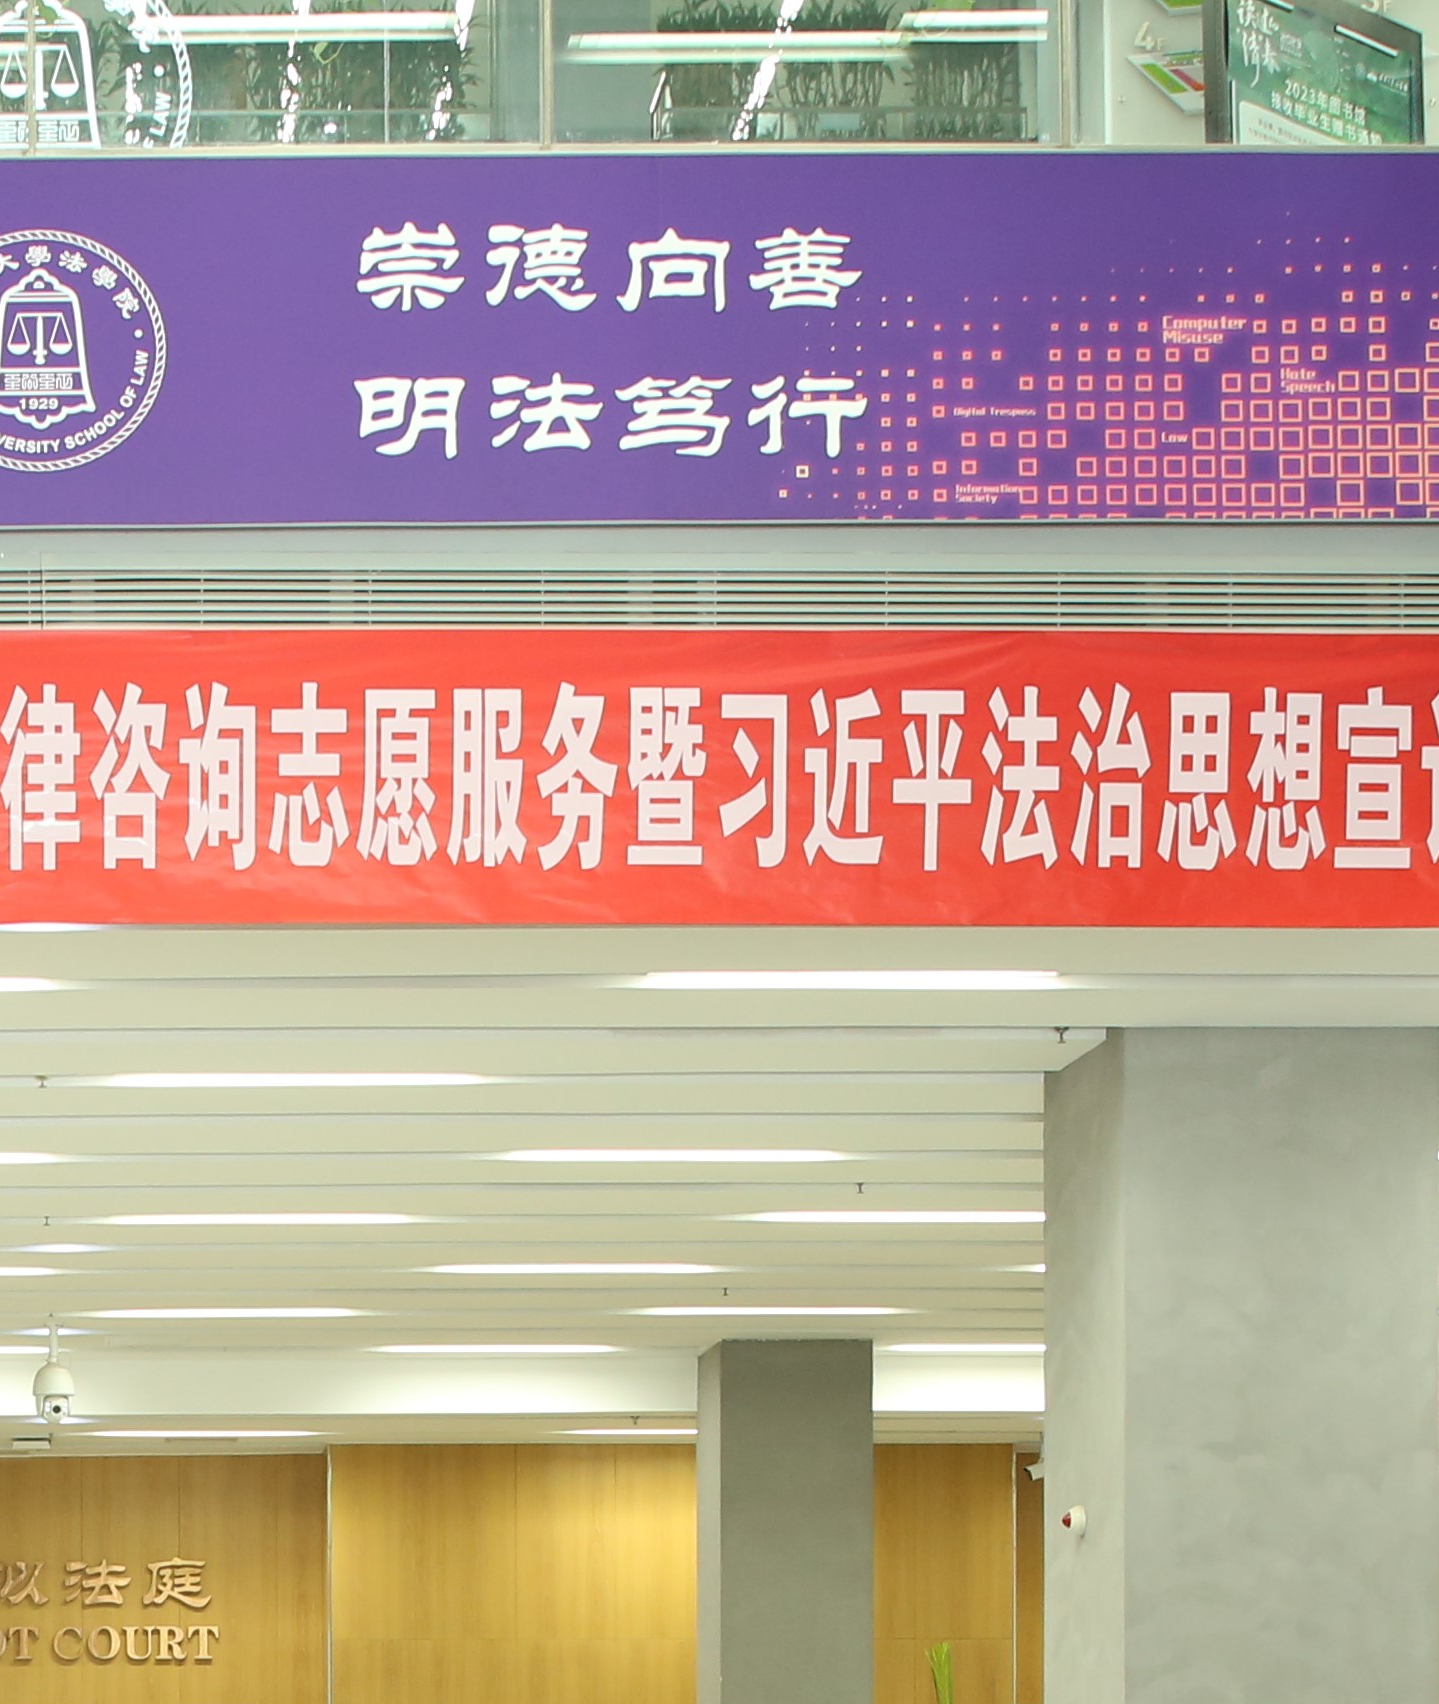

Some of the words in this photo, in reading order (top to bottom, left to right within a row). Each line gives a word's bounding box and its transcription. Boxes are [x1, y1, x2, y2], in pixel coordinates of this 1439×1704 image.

[356, 221, 863, 313] 崇德向善
[1162, 315, 1247, 332] Computer
[1163, 329, 1225, 345] Misuse
[64, 408, 125, 450] SCHOOL
[119, 384, 140, 410] OF
[132, 349, 150, 386] LAW
[1280, 379, 1336, 395] Speech
[20, 397, 58, 411] 1929
[354, 371, 868, 459] 明法笃行
[53, 1624, 220, 1662] COURT
